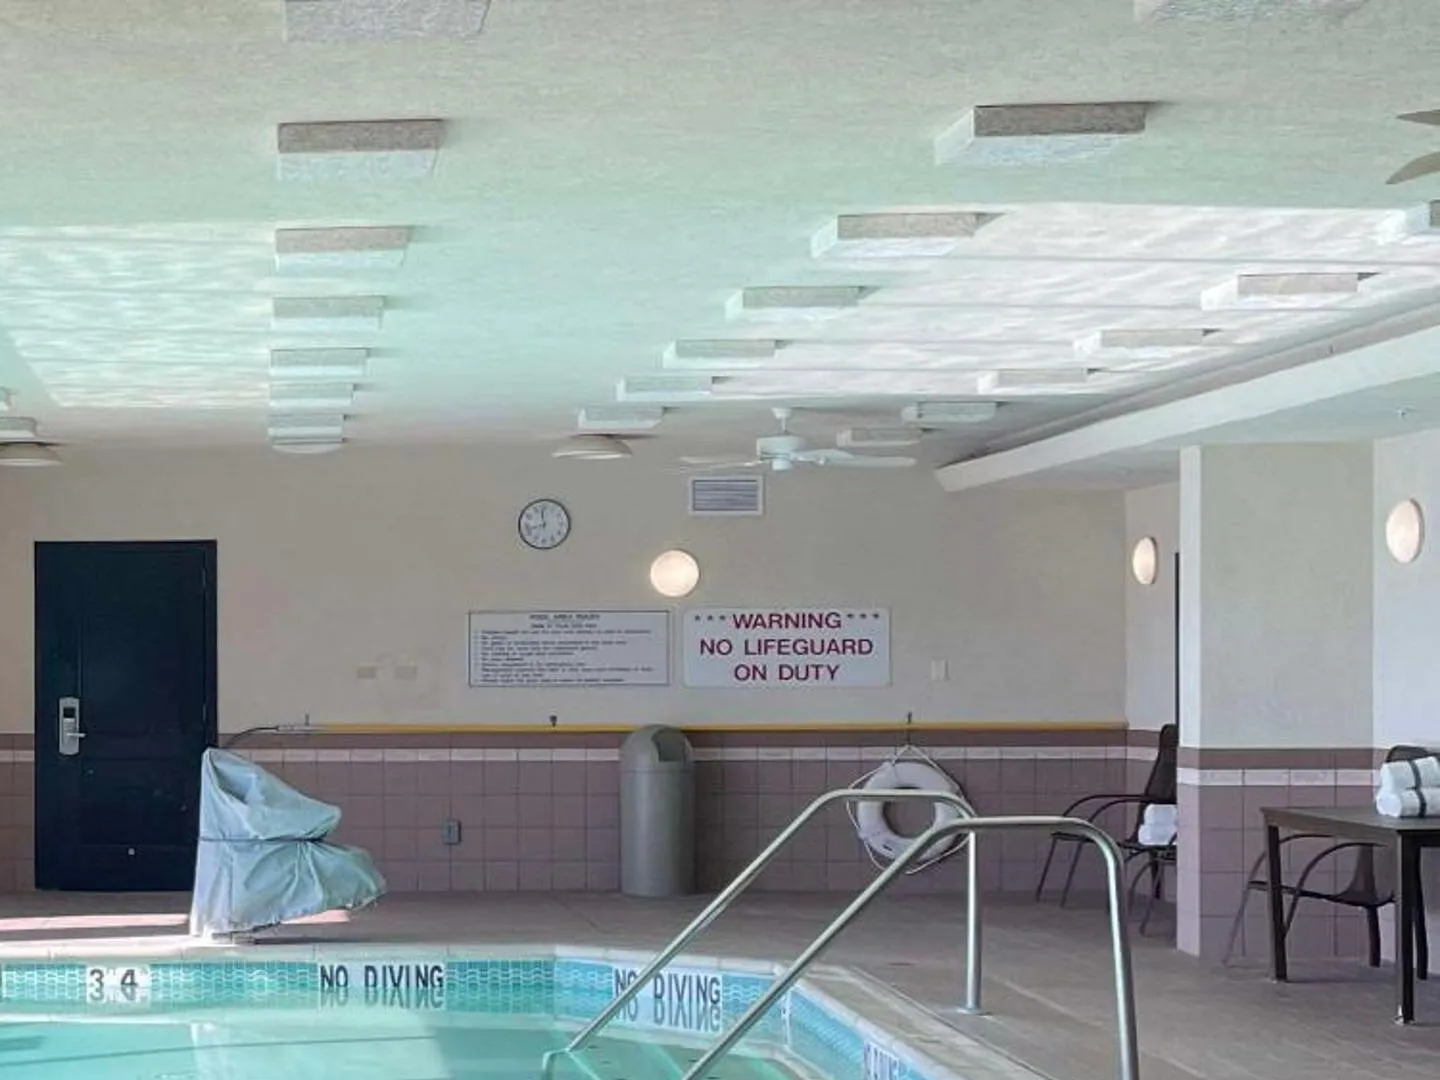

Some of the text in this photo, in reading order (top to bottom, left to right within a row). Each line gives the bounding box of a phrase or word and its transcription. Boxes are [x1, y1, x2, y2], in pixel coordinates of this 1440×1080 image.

[731, 612, 842, 629] WARNING
[699, 638, 874, 655] NO LIFEGUARD
[733, 663, 840, 681] ON DUTY
[320, 964, 444, 988] NO DIVING
[653, 973, 721, 1004] DIVING
